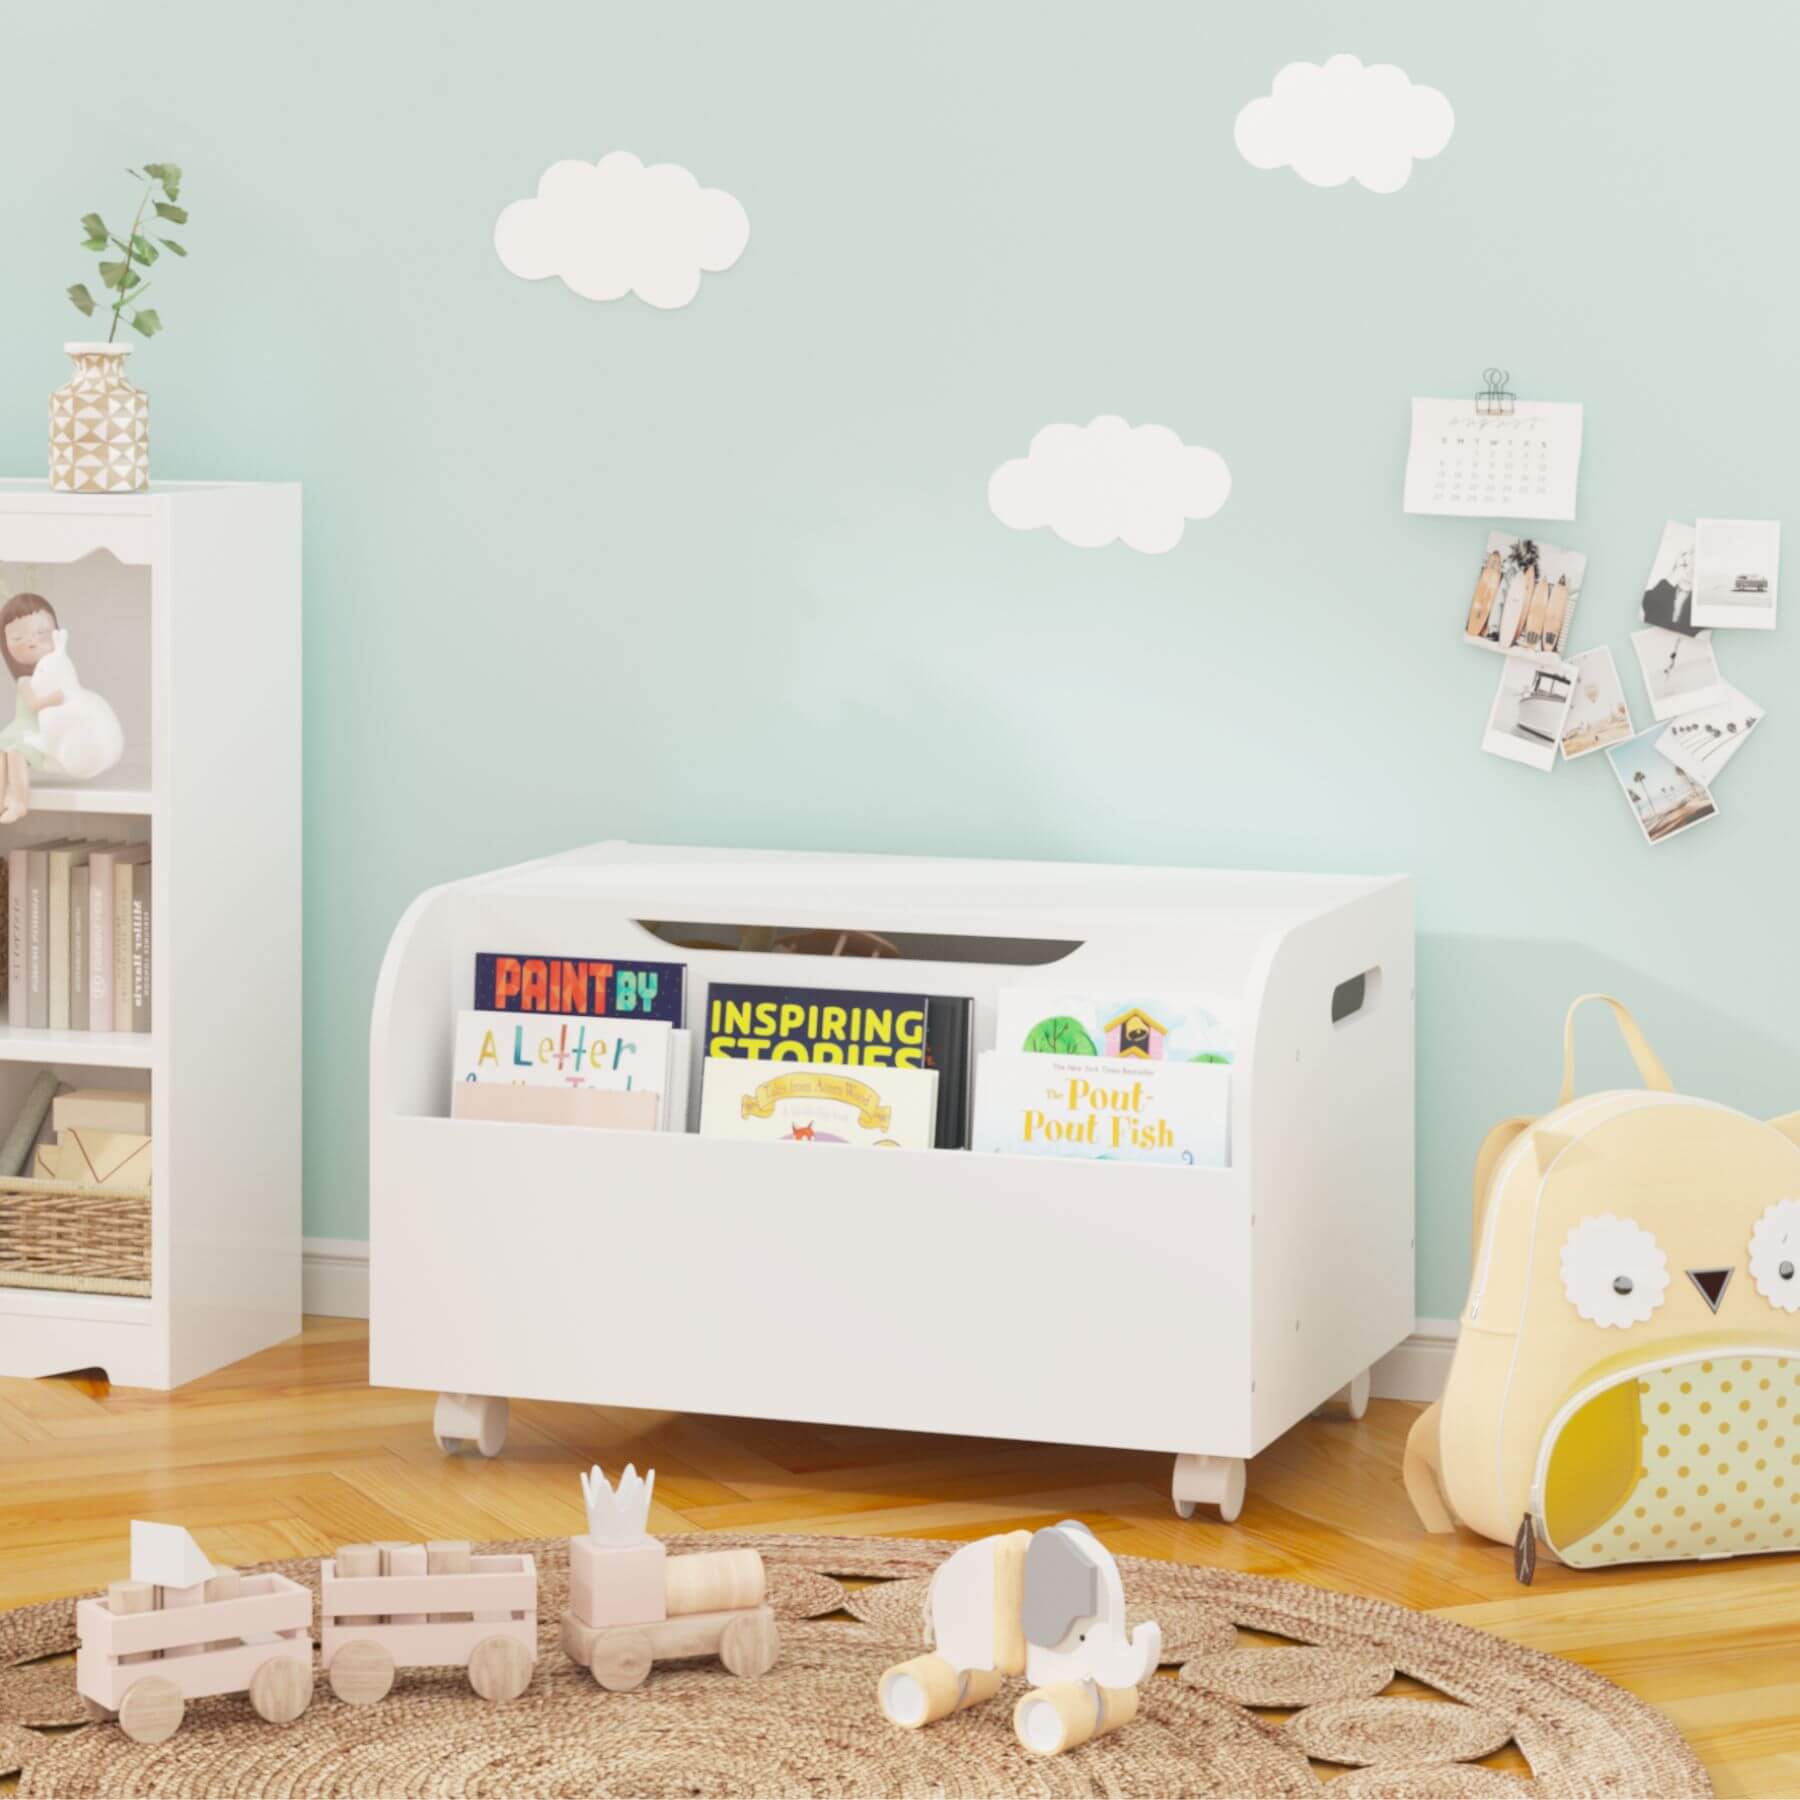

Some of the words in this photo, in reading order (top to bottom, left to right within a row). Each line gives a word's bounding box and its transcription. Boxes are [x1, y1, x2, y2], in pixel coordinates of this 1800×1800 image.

[494, 957, 614, 1015] PAINT
[615, 970, 659, 1013] BY
[710, 999, 925, 1045] INSPIRING
[478, 1028, 499, 1068] A
[513, 1023, 638, 1073] Letter
[709, 1036, 924, 1070] STORIES
[1065, 1077, 1155, 1114] Pout-
[1021, 1108, 1098, 1145] Pout
[1109, 1115, 1175, 1150] Fish
